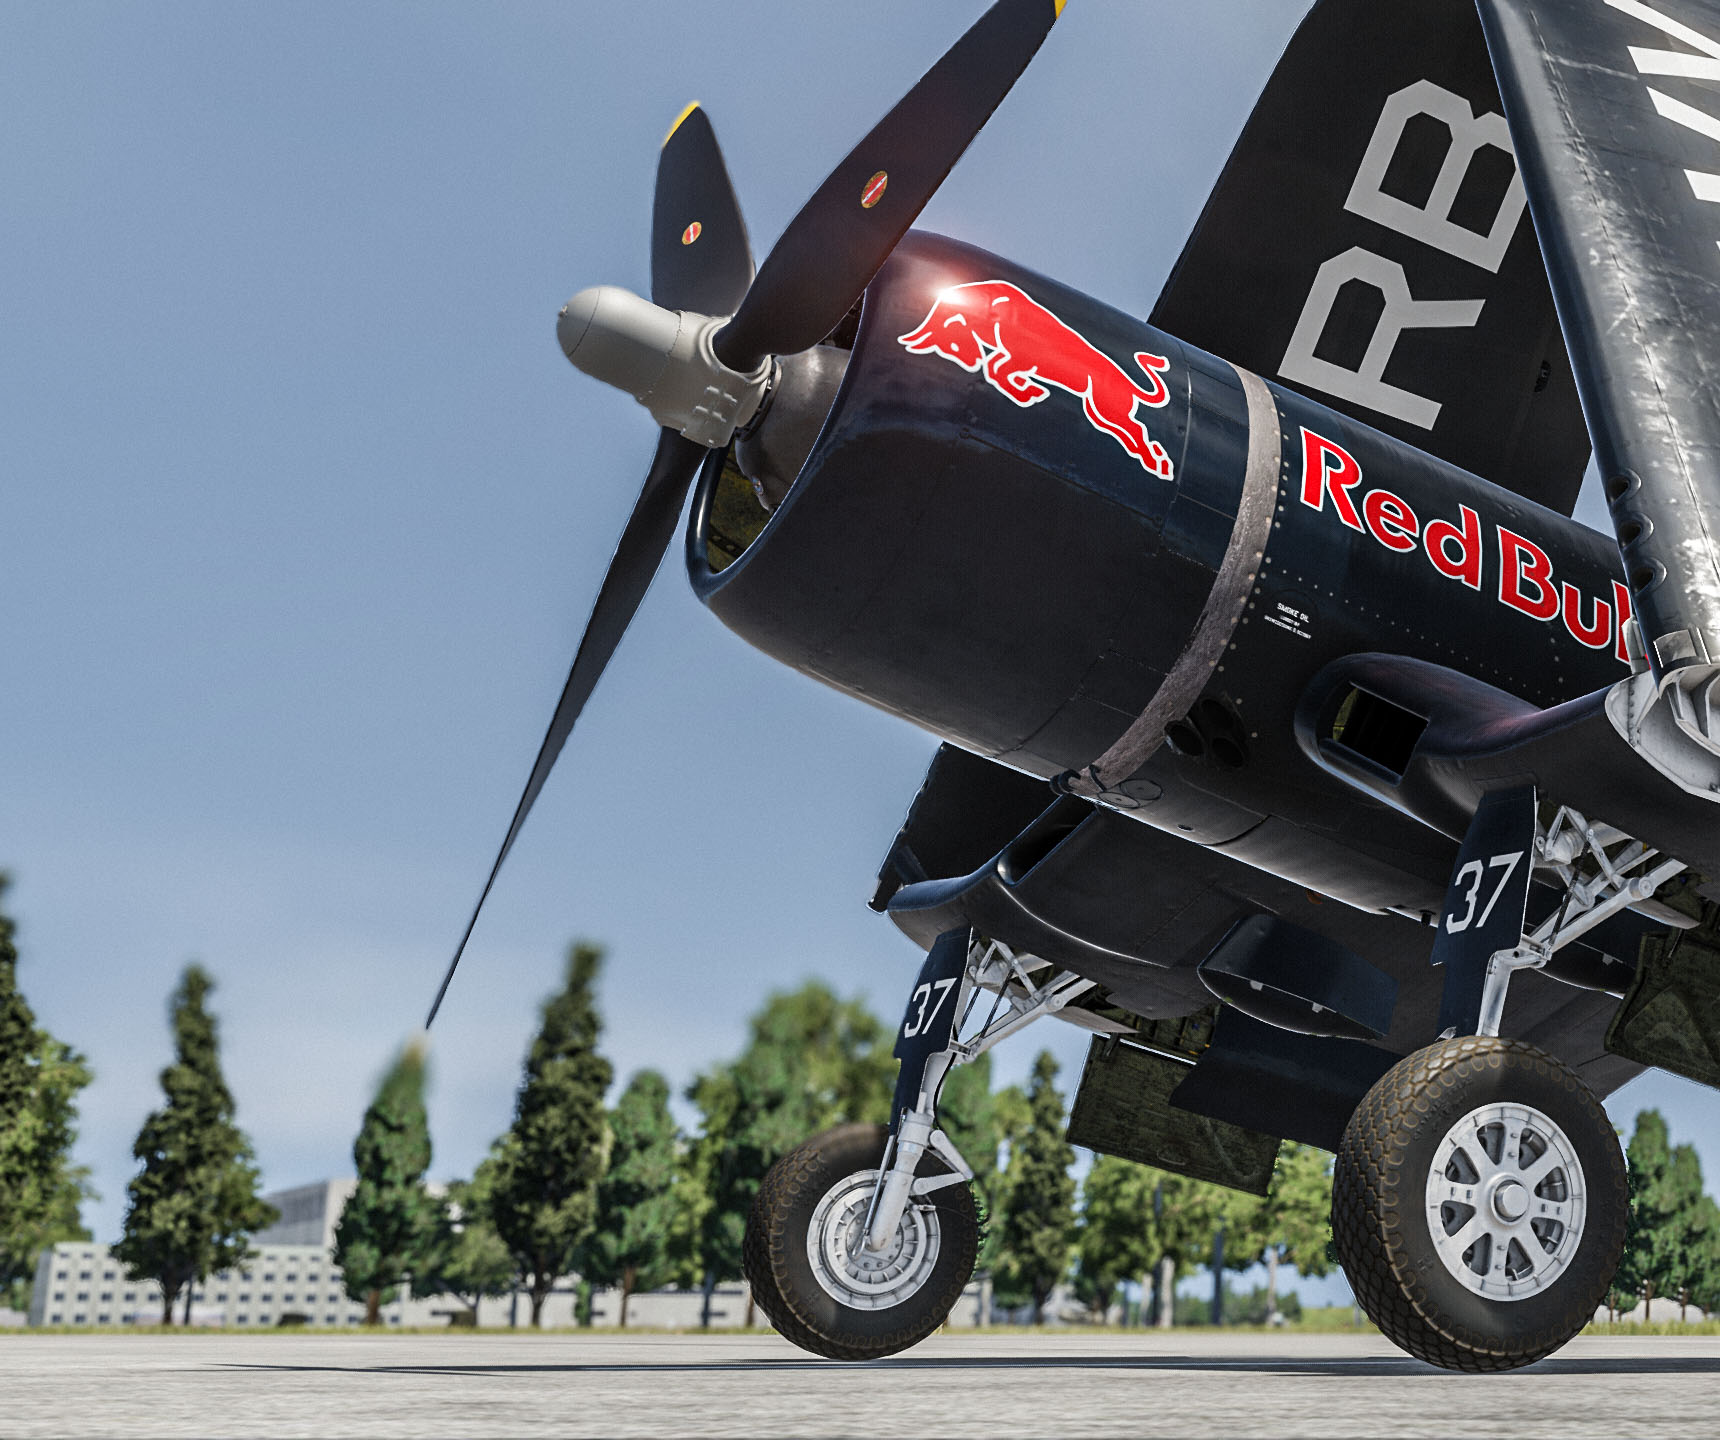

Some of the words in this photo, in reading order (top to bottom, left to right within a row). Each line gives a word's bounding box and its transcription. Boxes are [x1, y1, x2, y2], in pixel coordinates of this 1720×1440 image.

[1278, 79, 1528, 430] RB
[1300, 426, 1481, 590] Red
[1497, 524, 1651, 669] Bul
[1446, 850, 1525, 935] 37
[903, 977, 958, 1039] 37
